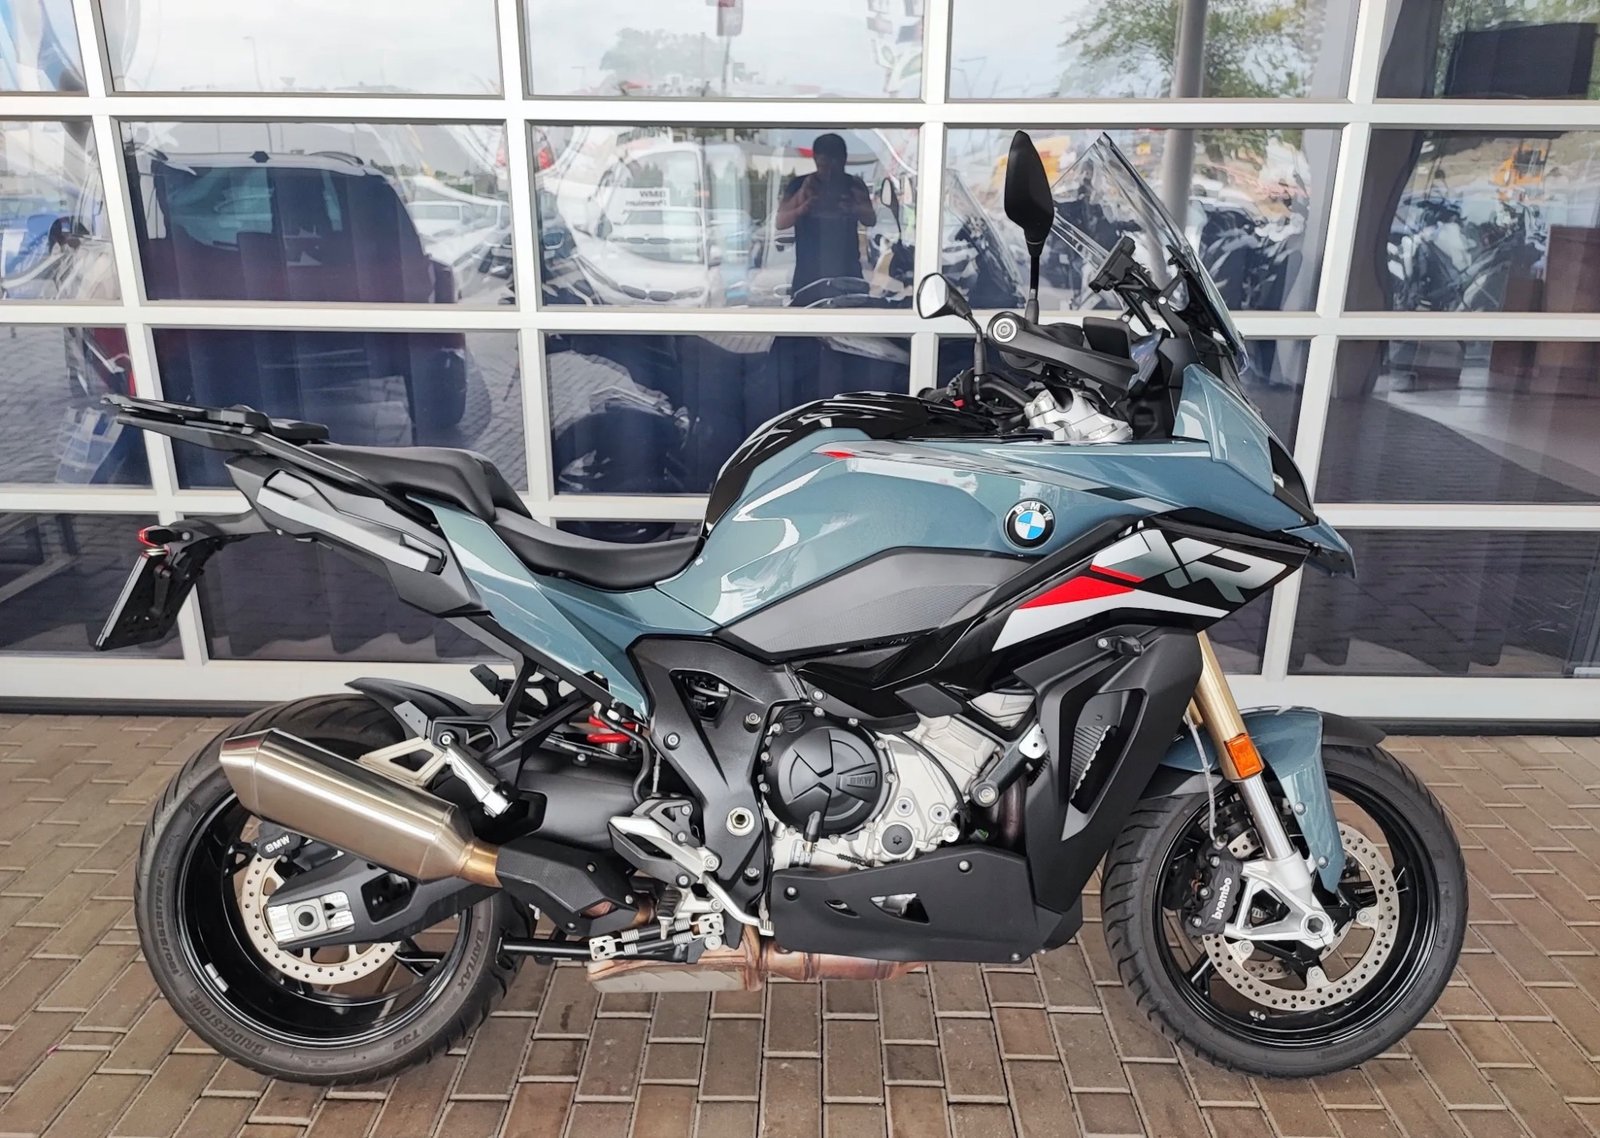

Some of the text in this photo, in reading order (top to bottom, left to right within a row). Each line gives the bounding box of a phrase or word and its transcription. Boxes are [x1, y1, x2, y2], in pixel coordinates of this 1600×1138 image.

[1014, 502, 1053, 521] BMW
[1090, 528, 1288, 604] XR
[849, 776, 873, 785] BMW
[265, 835, 290, 853] BMW
[1211, 877, 1233, 920] brembo
[457, 930, 486, 991] BATTLAX
[186, 992, 268, 1057] BRIDGESTONE
[393, 1028, 423, 1051] T32
